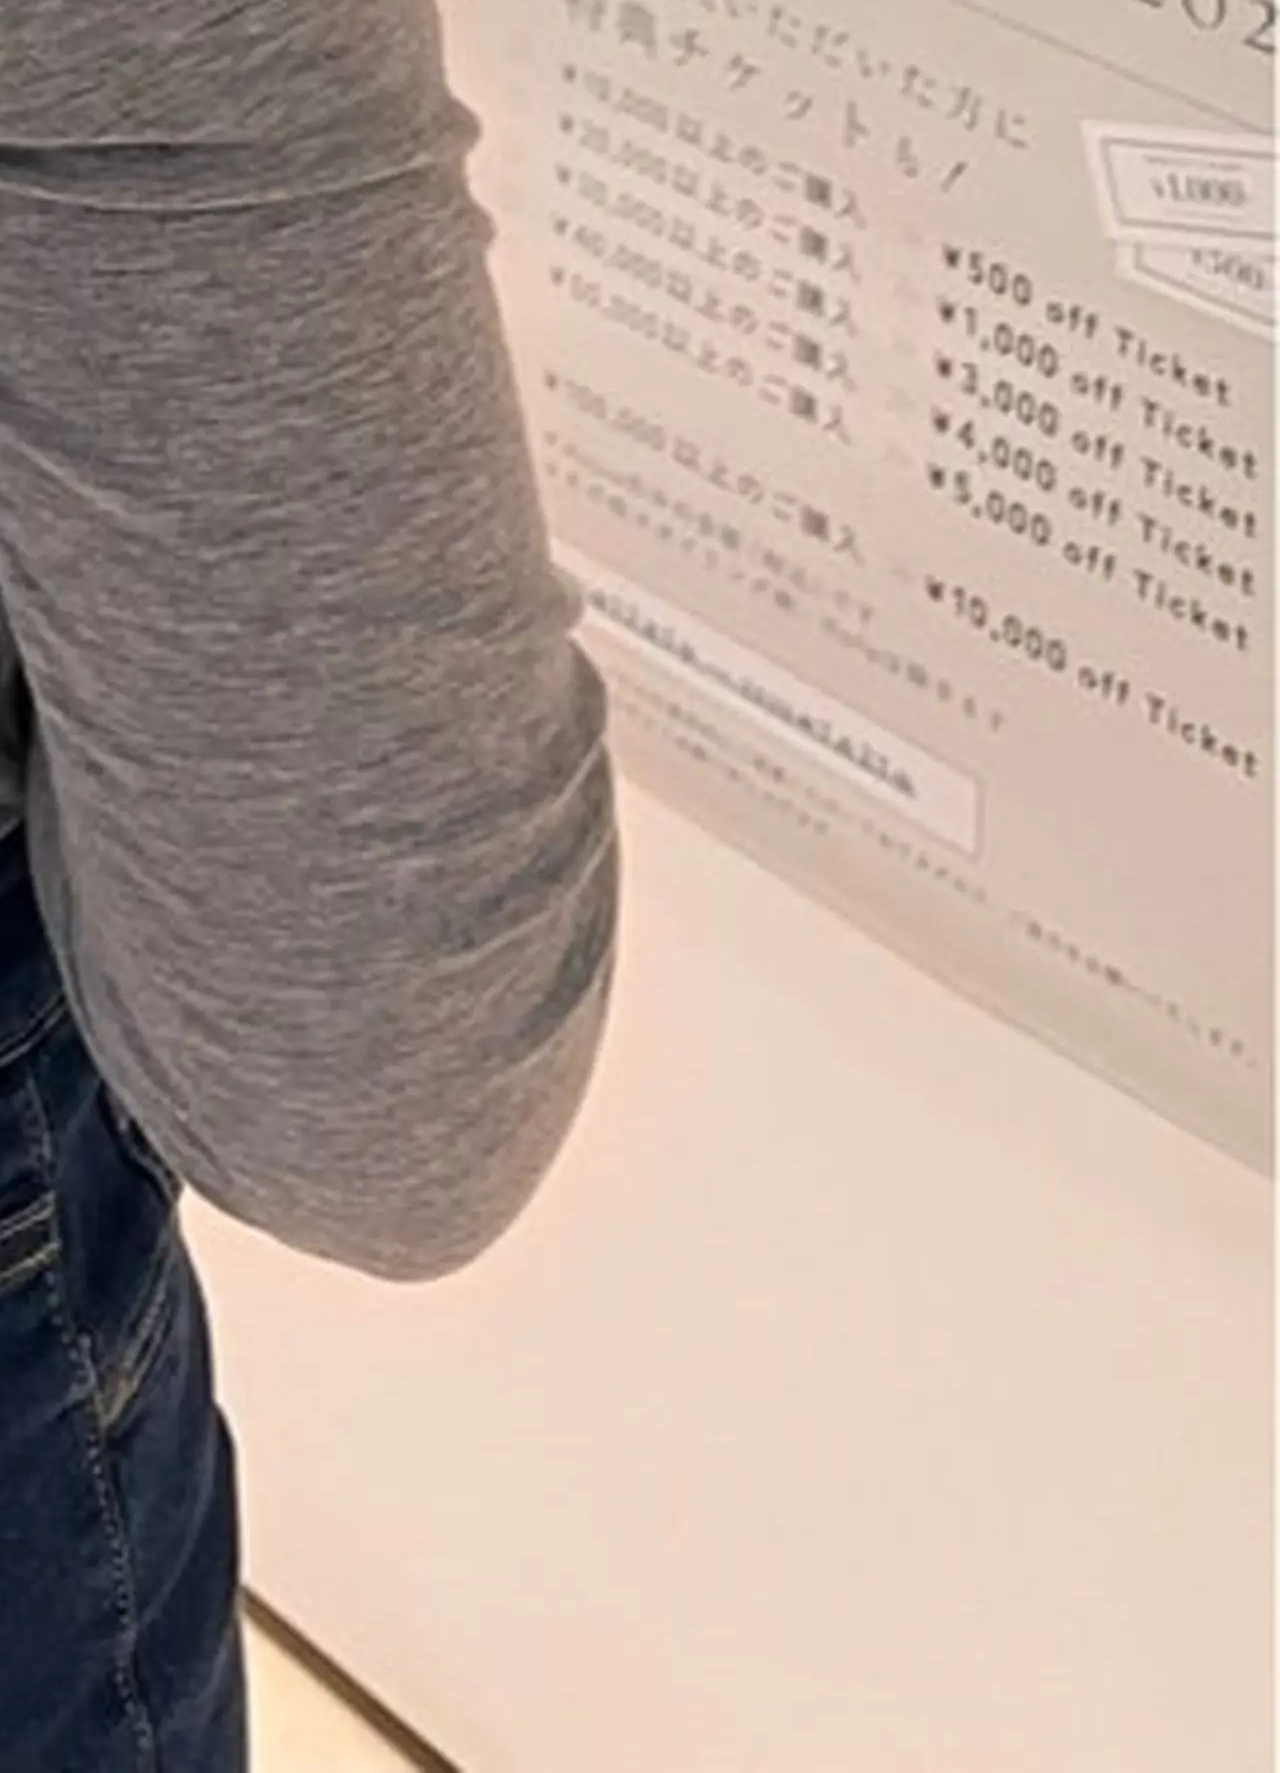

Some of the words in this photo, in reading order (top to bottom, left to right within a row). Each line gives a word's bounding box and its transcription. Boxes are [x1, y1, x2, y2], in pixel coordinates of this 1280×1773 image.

[937, 295, 1060, 379] ¥1,000
[1071, 372, 1125, 412] off
[1141, 396, 1258, 481] Ticket
[942, 242, 1033, 306] ¥500
[1046, 302, 1100, 341] off
[1114, 324, 1231, 407] Ticket
[930, 405, 1058, 494] ¥4,000
[1068, 486, 1123, 529] off
[1137, 511, 1256, 598] Ticket
[1070, 429, 1126, 472] off
[1139, 455, 1258, 540] Ticket
[925, 574, 1068, 673] ¥10,000
[1077, 666, 1131, 706] off
[1144, 691, 1258, 780] Ticket
[1062, 541, 1118, 584] off
[1131, 566, 1249, 653] Ticket
